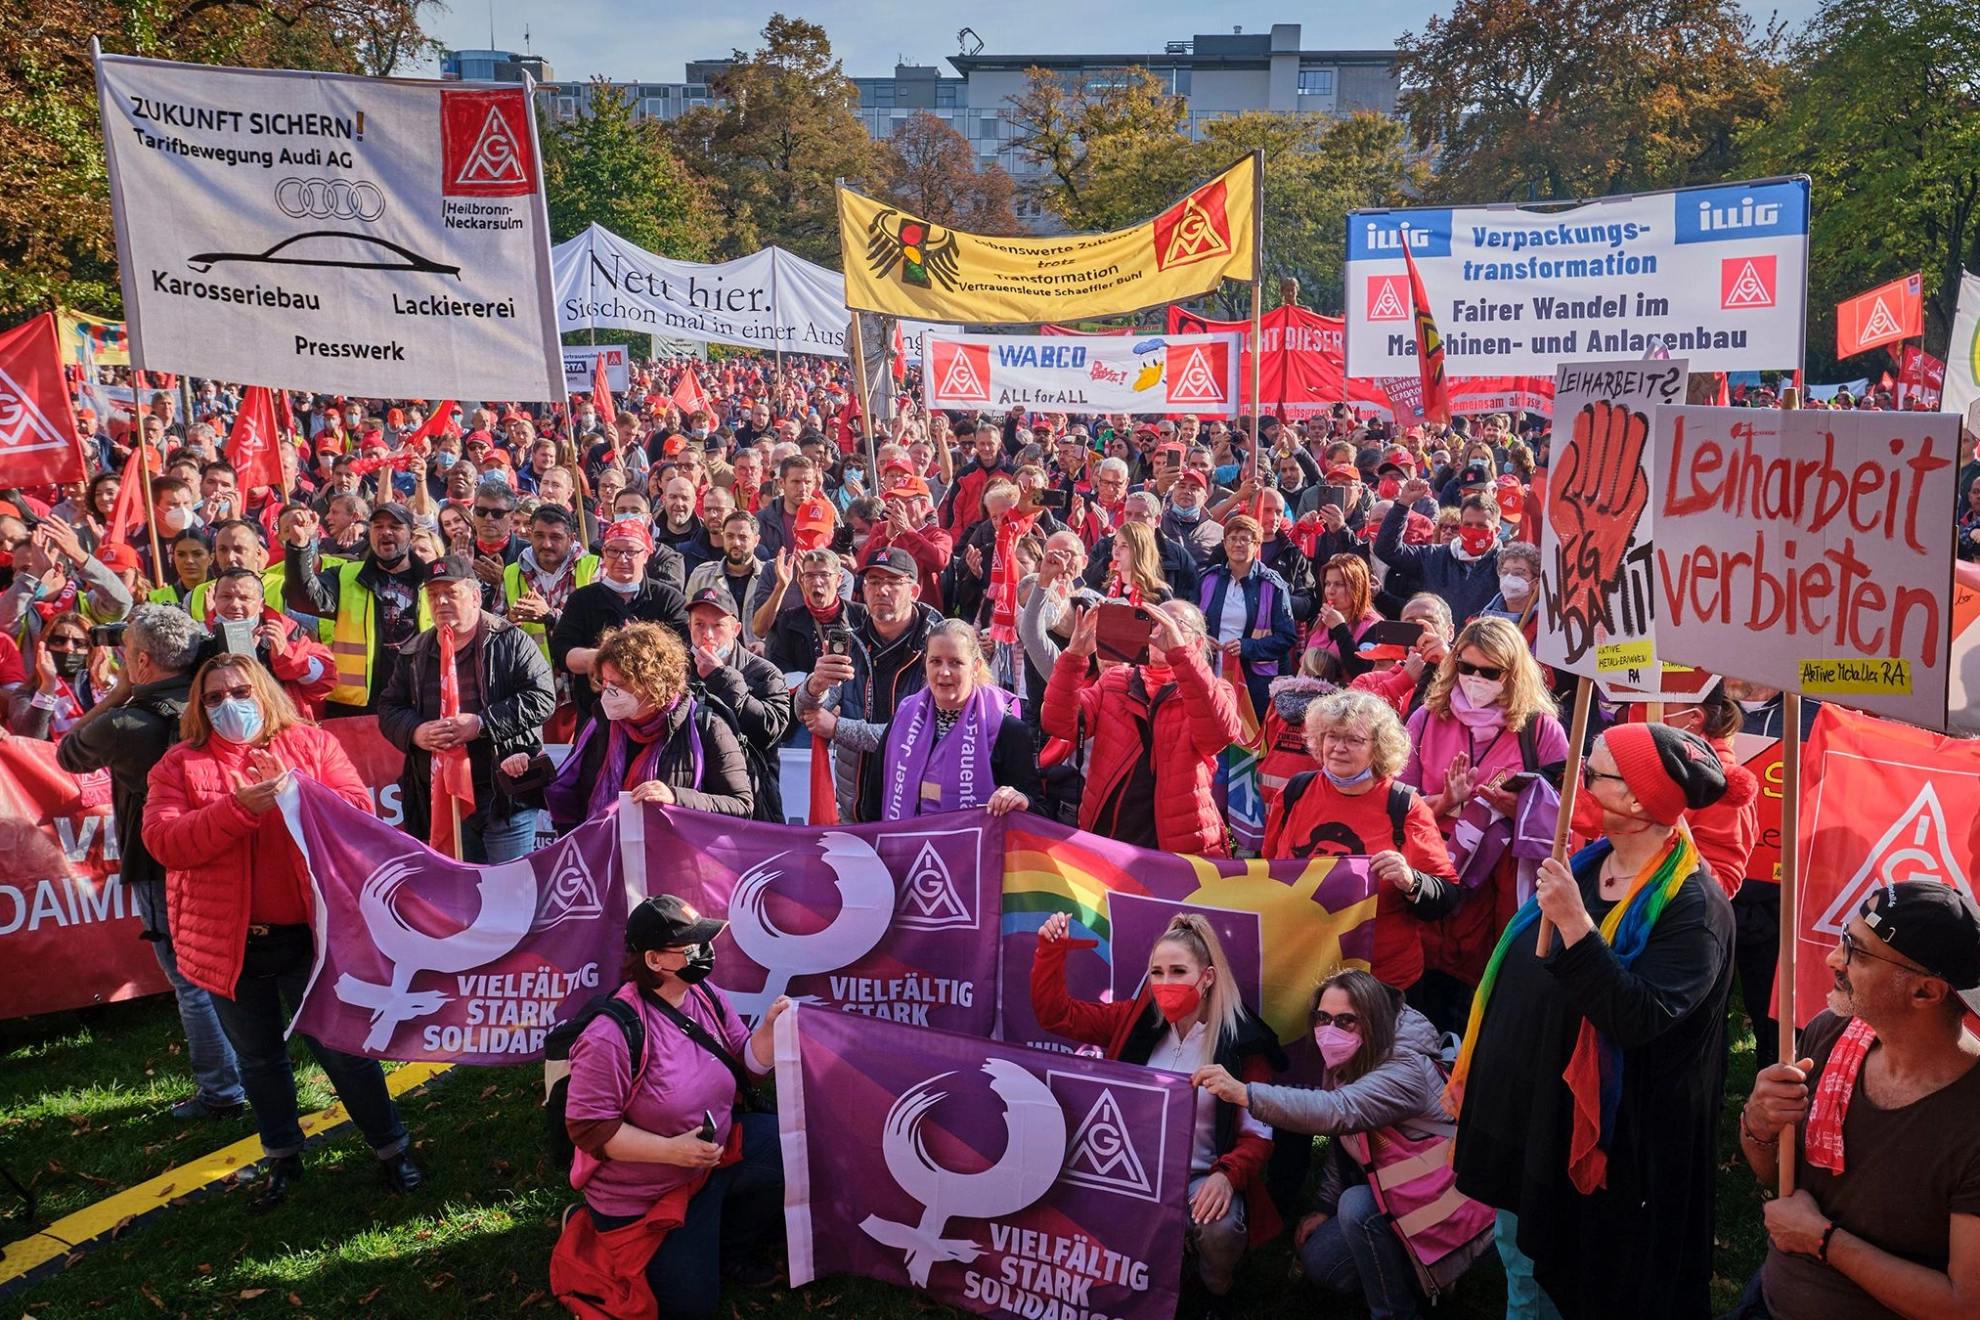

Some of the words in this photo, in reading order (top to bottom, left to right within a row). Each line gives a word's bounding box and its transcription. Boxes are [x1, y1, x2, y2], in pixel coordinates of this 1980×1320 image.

[131, 97, 242, 134] ZUKUNFT
[250, 110, 364, 142] SICHERN!
[133, 127, 273, 168] Tarifbewegung
[279, 147, 321, 167] Audi
[327, 151, 353, 169] AG
[445, 216, 523, 230] Neckarsulm
[447, 203, 513, 217] Heilbronn-
[1472, 222, 1651, 249] Verpackungs-
[994, 264, 1119, 285] Transformation
[1038, 258, 1076, 268] trotz
[1464, 250, 1657, 281] transformation
[152, 270, 320, 311] Karosseriebau
[589, 249, 676, 301] Nett
[689, 276, 772, 312] hier.
[959, 281, 1052, 297] Vertrauensleute
[1055, 281, 1114, 296] Schaeffler
[393, 294, 515, 318] Lackiererei
[1453, 298, 1523, 322] Fairer
[1533, 294, 1627, 321] Wandel
[1636, 292, 1669, 317] im
[665, 311, 705, 331] mal
[713, 317, 734, 335] in
[742, 319, 796, 340] einer
[1285, 326, 1344, 353] DIESER
[295, 336, 405, 361] Presswerk
[999, 345, 1087, 369] WABCO
[1388, 333, 1523, 356] Mahinen-
[1532, 330, 1577, 354] und
[998, 387, 1031, 405] ALL
[1034, 388, 1055, 403] for
[1056, 387, 1088, 404] ALL
[1662, 414, 1952, 556] Leiharbeit
[1658, 531, 1940, 669] verbieten
[1628, 668, 1640, 683] RA
[1881, 661, 1906, 686] RA
[888, 760, 907, 821] Unser
[456, 962, 599, 999] VIELFÄLTIG
[830, 972, 974, 1008] VIELFÄLTIG
[465, 998, 557, 1026] STARK
[990, 1222, 1149, 1292] VIELFÄLTIG
[1000, 1256, 1093, 1307] STARK
